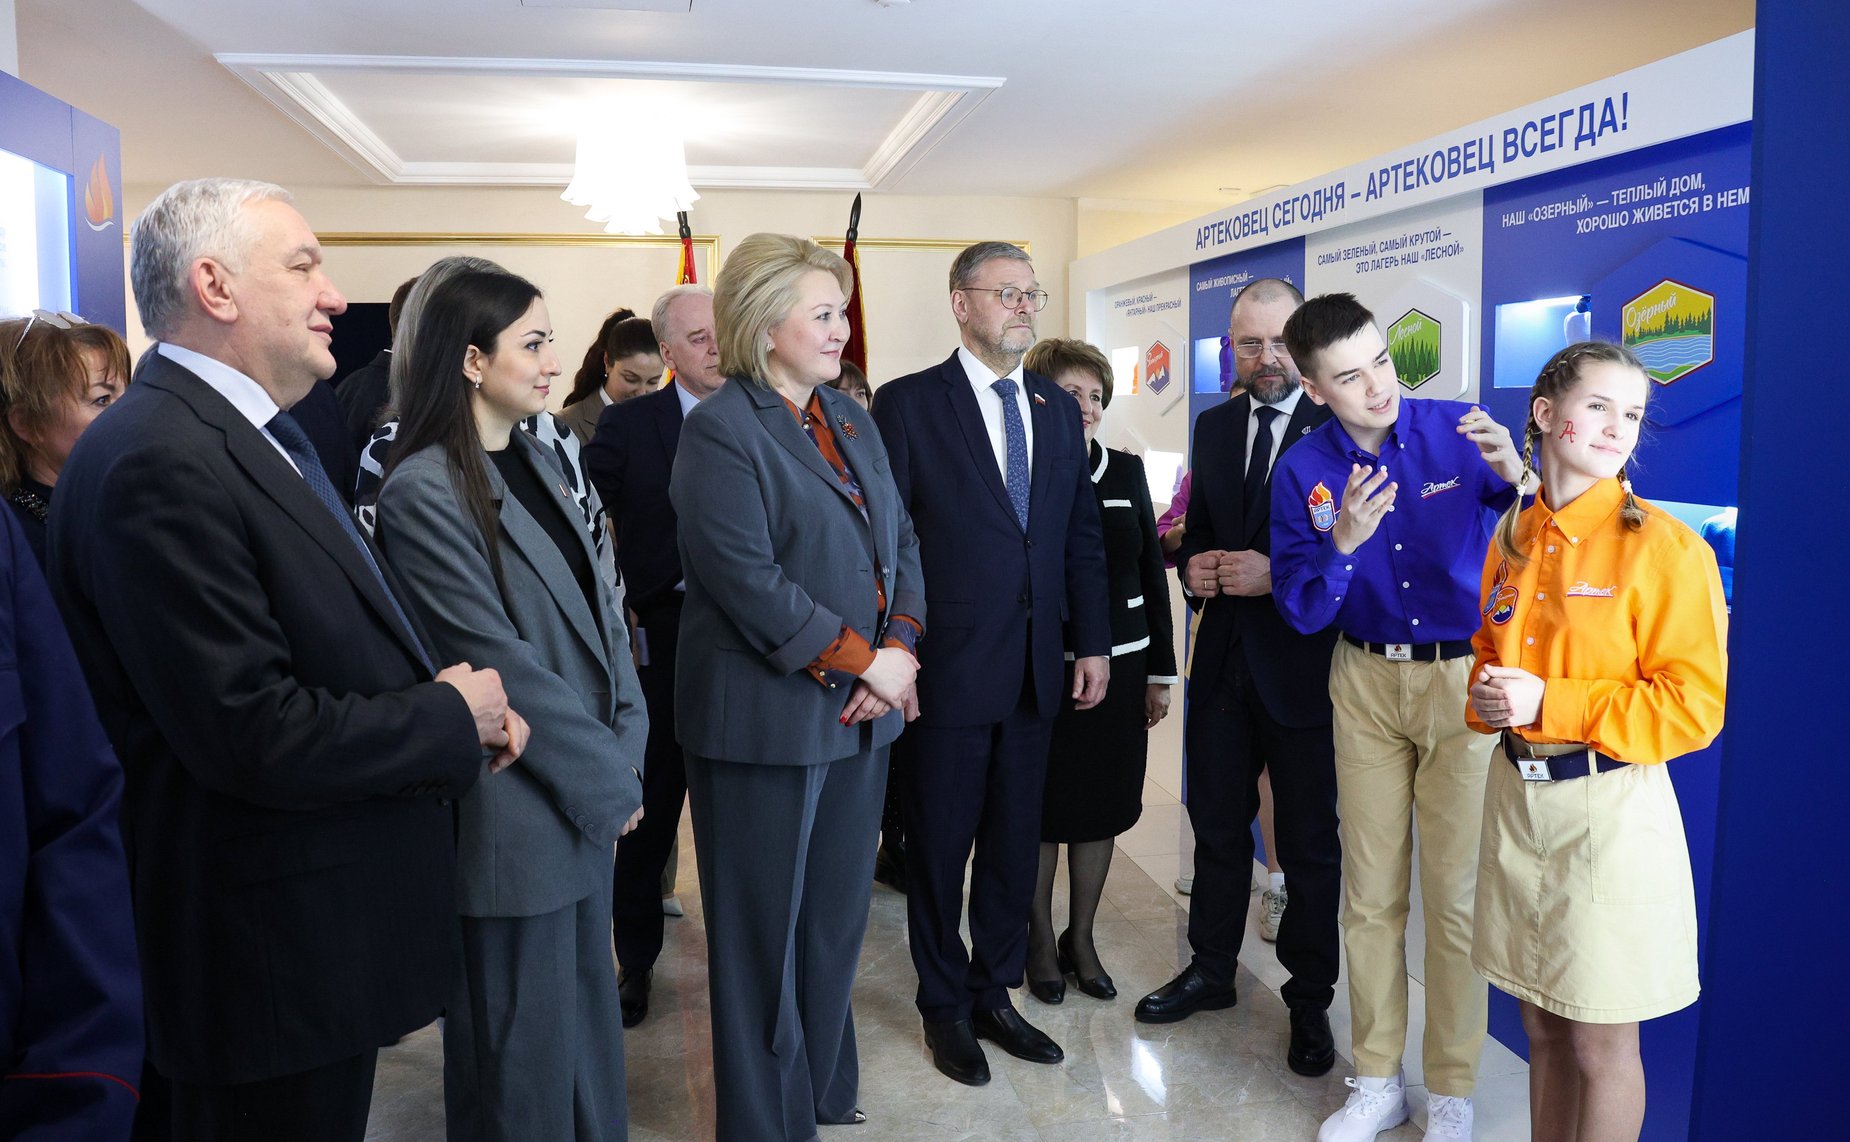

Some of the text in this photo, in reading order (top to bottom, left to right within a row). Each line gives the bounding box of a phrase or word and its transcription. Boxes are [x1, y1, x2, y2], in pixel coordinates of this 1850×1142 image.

[1196, 207, 1269, 250] АРТЕКОВЕЦ
[1272, 182, 1345, 228] СЕГОДНЯ
[1366, 134, 1494, 202] АРТЕКОВЕЦ
[1503, 91, 1629, 164] ВСЕГДА!
[1502, 210, 1525, 228] НАШ
[1528, 193, 1593, 222] «ОЗЕРНЫЙ»
[1612, 176, 1667, 206] ТЕПЛЫЙ
[1669, 172, 1706, 198] ДОМ,
[1576, 186, 1750, 234] ХОРОШО ЖИВЕТСЯ В НЕМ
[1317, 247, 1342, 266] САМЫЙ
[1343, 240, 1378, 261] ЗЕЛЕНЫЙ,
[1379, 234, 1408, 253] САМЫЙ
[1409, 226, 1441, 247] КРУТОЙ
[1355, 240, 1464, 274] ЭТО ЛАГЕРЬ НАШ «ЛЕСНОЙ»
[1196, 277, 1213, 292] САМЫЙ
[1213, 270, 1248, 288] ЖИВОПИСНЫЙ
[1390, 318, 1422, 346] Лесной
[1626, 292, 1677, 333] Озёрный
